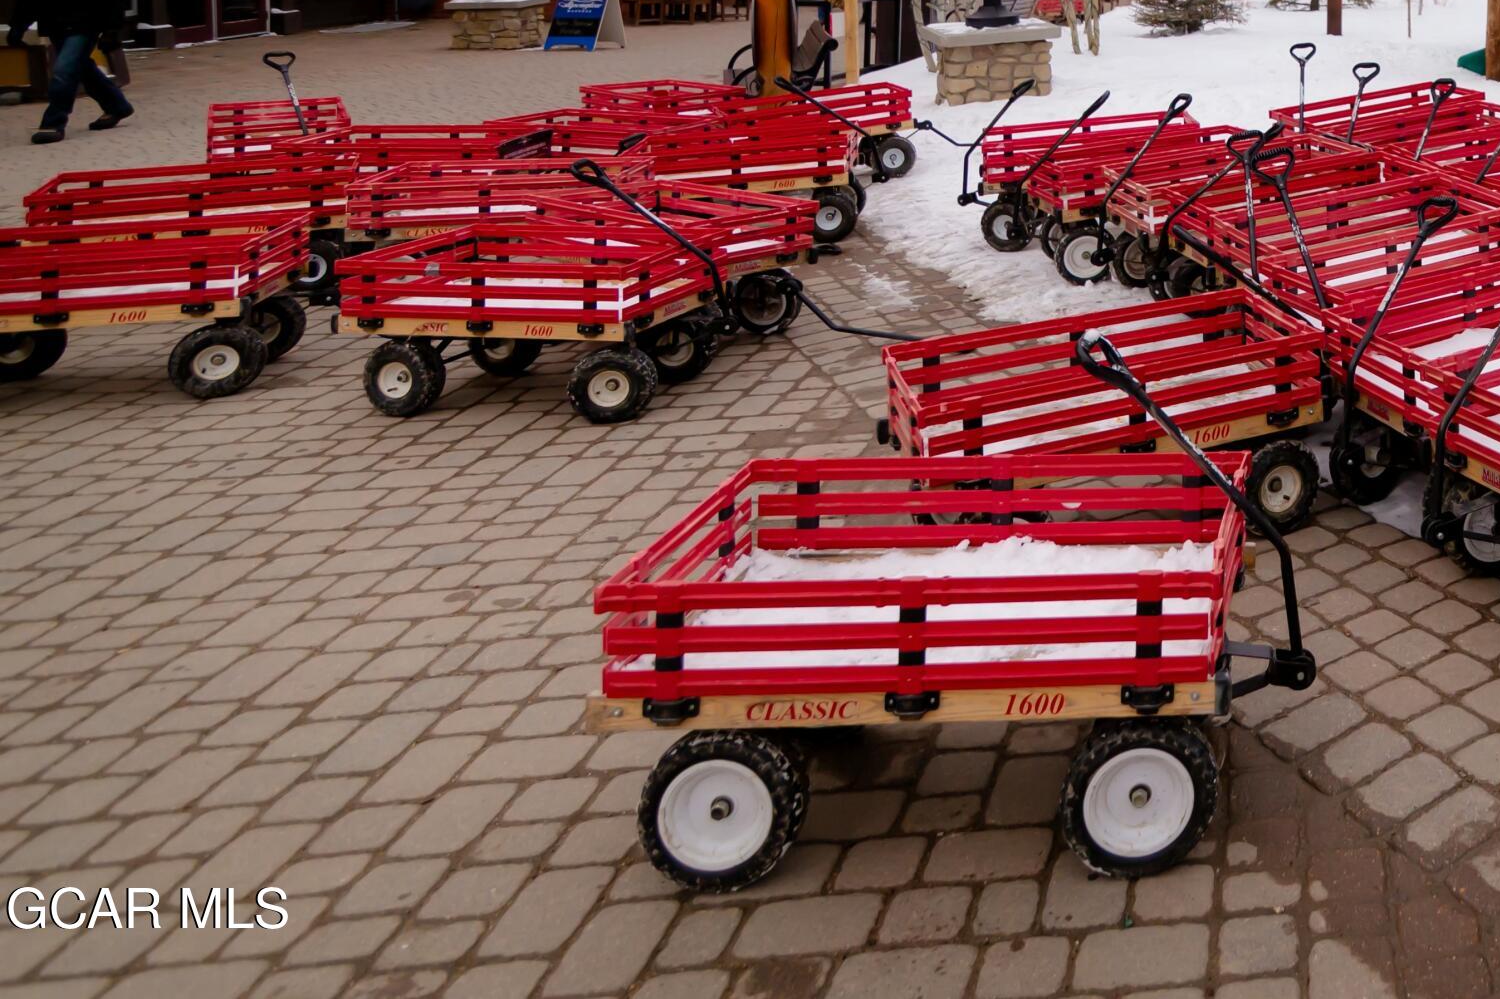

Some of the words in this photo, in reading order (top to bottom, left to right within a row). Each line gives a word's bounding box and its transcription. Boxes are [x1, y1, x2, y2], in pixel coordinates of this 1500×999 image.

[110, 311, 148, 323] 1600
[525, 324, 553, 337] 1600
[1194, 423, 1230, 445] 1600
[746, 700, 858, 721] CLASSIC
[1004, 692, 1065, 716] 1600
